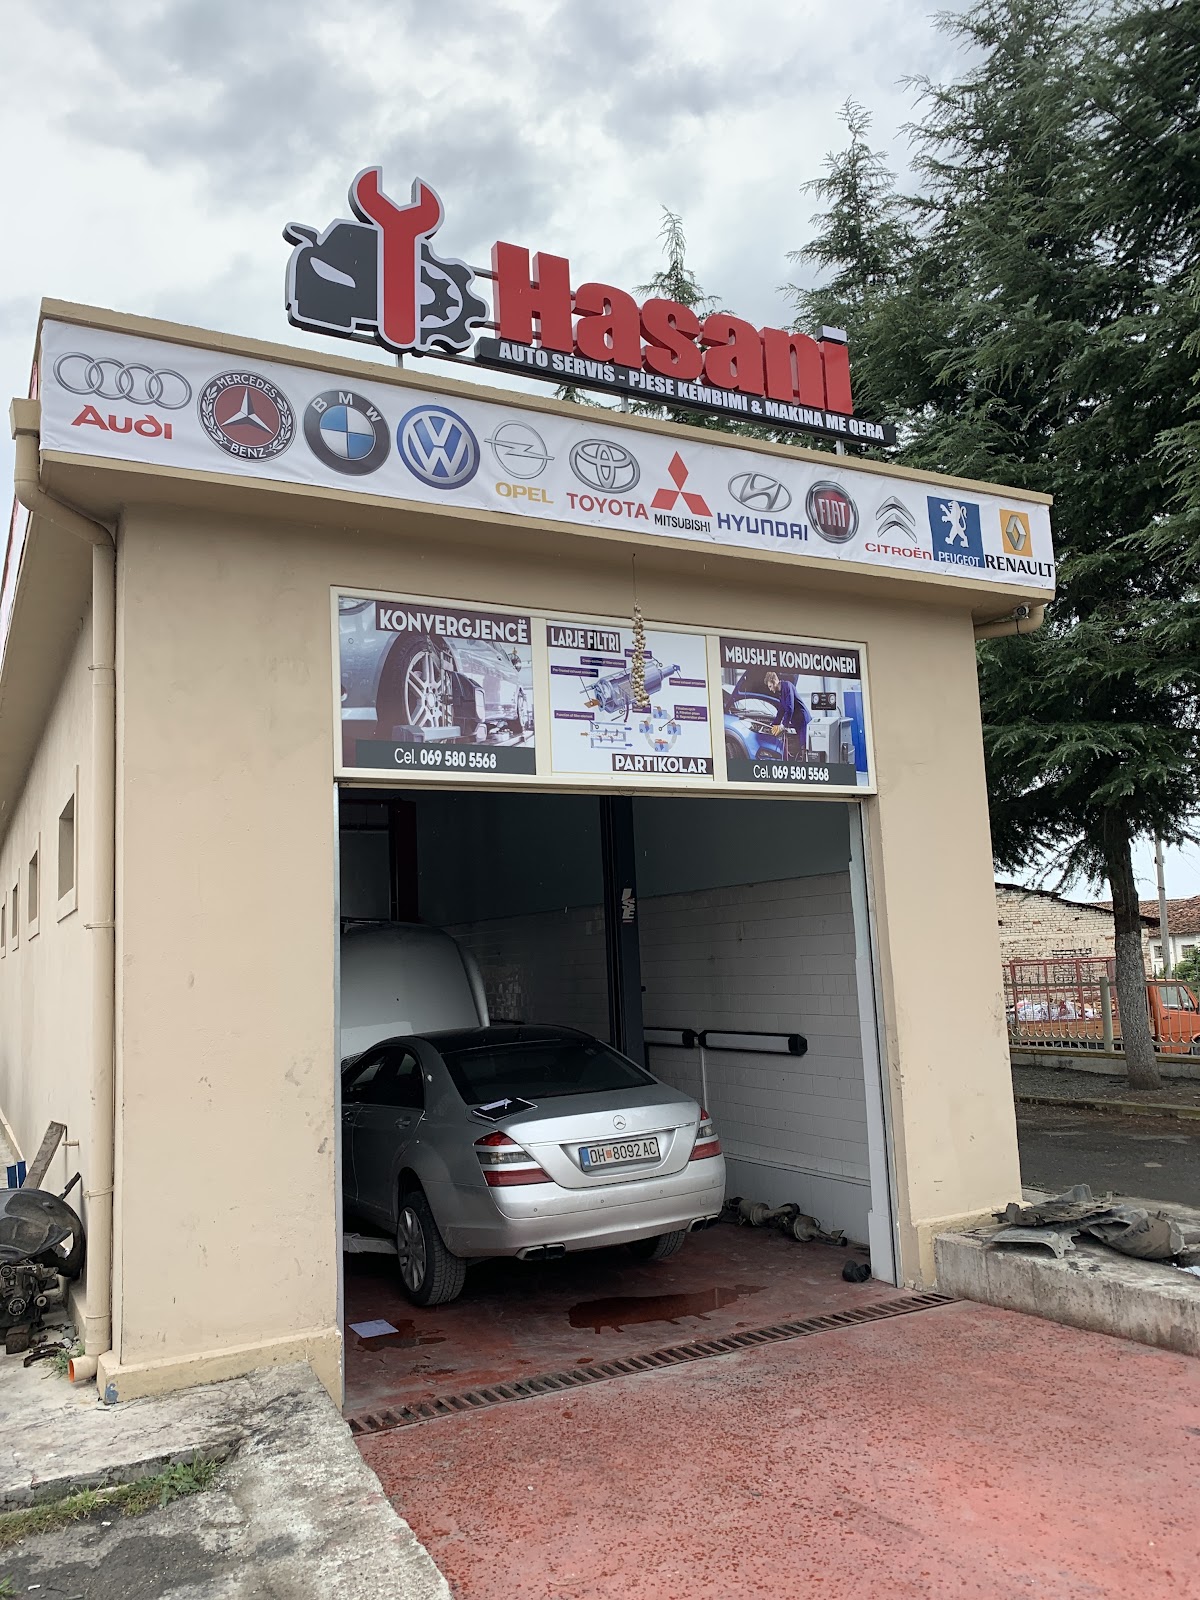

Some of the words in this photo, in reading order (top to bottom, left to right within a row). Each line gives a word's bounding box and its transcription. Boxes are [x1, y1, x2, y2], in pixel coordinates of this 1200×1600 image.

[491, 241, 853, 416] Hasani
[216, 374, 278, 399] MERCEDES
[499, 342, 548, 368] AUTO
[552, 353, 615, 382] SERVIS
[629, 370, 675, 396] PJESE
[677, 381, 748, 412] KEMBIMI
[750, 400, 763, 415] &
[765, 401, 824, 427] MAKINA
[826, 413, 847, 432] ME
[848, 419, 885, 440] QERA
[71, 404, 173, 440] Audi
[230, 443, 267, 458] BENZ
[495, 482, 554, 504] OPEL
[566, 492, 649, 520] TOYOTA
[818, 498, 847, 528] FIAT
[654, 514, 711, 533] MITSUBISHI
[717, 512, 808, 541] HYUNDAI
[938, 551, 980, 567] PEUGEOT
[985, 554, 1054, 578] RENAULT
[379, 608, 528, 643] KONVERGJENCË
[550, 627, 584, 649] LARJE
[587, 631, 620, 652] FILTRI
[725, 645, 778, 667] MBUSHJE
[779, 650, 857, 674] KONDICIONERI
[394, 747, 418, 765] Cel.
[420, 749, 443, 766] 069
[444, 751, 467, 768] 580
[468, 752, 497, 769] 5568
[614, 754, 707, 774] PARTIKOLAR
[753, 764, 771, 779] Cel.
[771, 766, 789, 780] 069
[790, 767, 808, 780] 580
[808, 768, 830, 781] 5568
[589, 1149, 606, 1164] OH
[612, 1143, 642, 1160] 8092
[643, 1141, 657, 1156] AC
